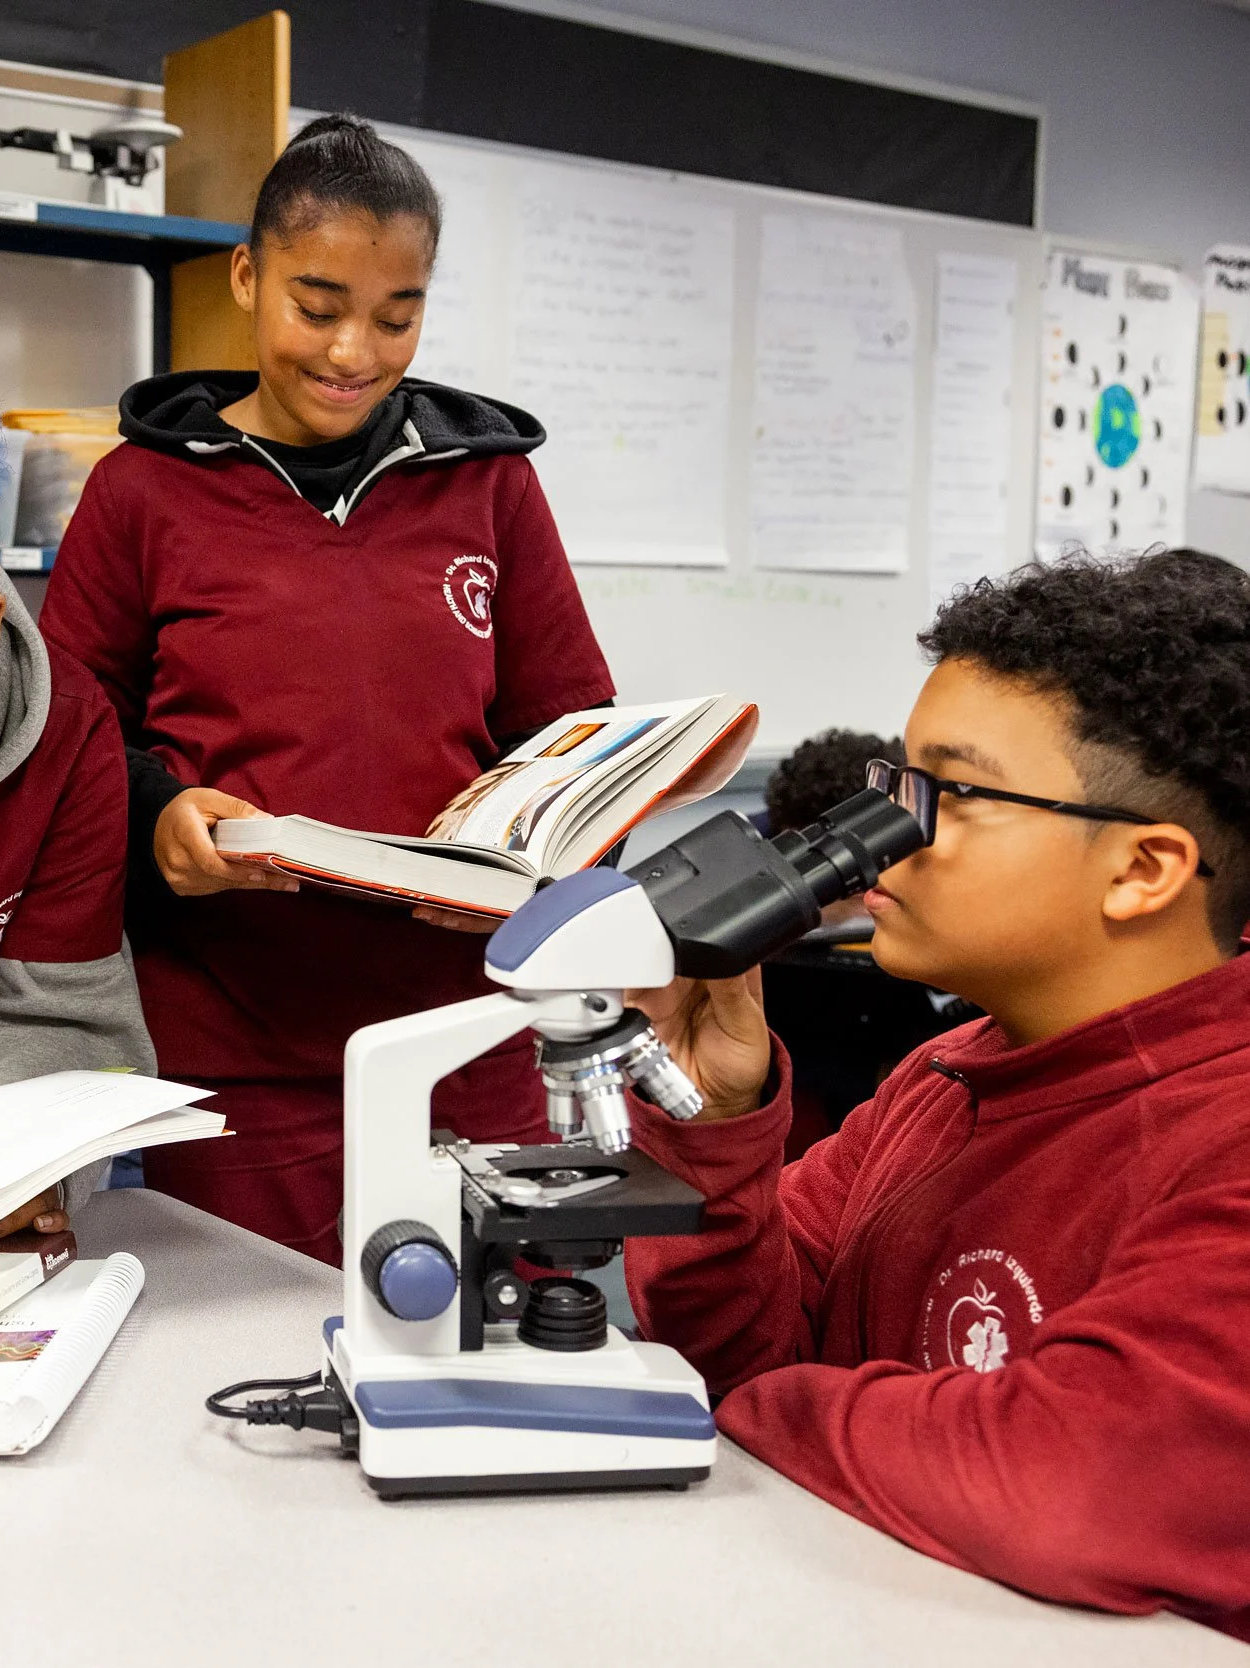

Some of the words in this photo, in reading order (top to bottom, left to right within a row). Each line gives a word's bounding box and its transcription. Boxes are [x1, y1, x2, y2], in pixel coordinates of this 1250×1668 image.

[453, 555, 482, 567] Richard
[443, 584, 458, 611] HEALTH
[453, 609, 467, 624] AND
[959, 1249, 1003, 1267] Richard
[1005, 1256, 1043, 1323] Izquierdo
